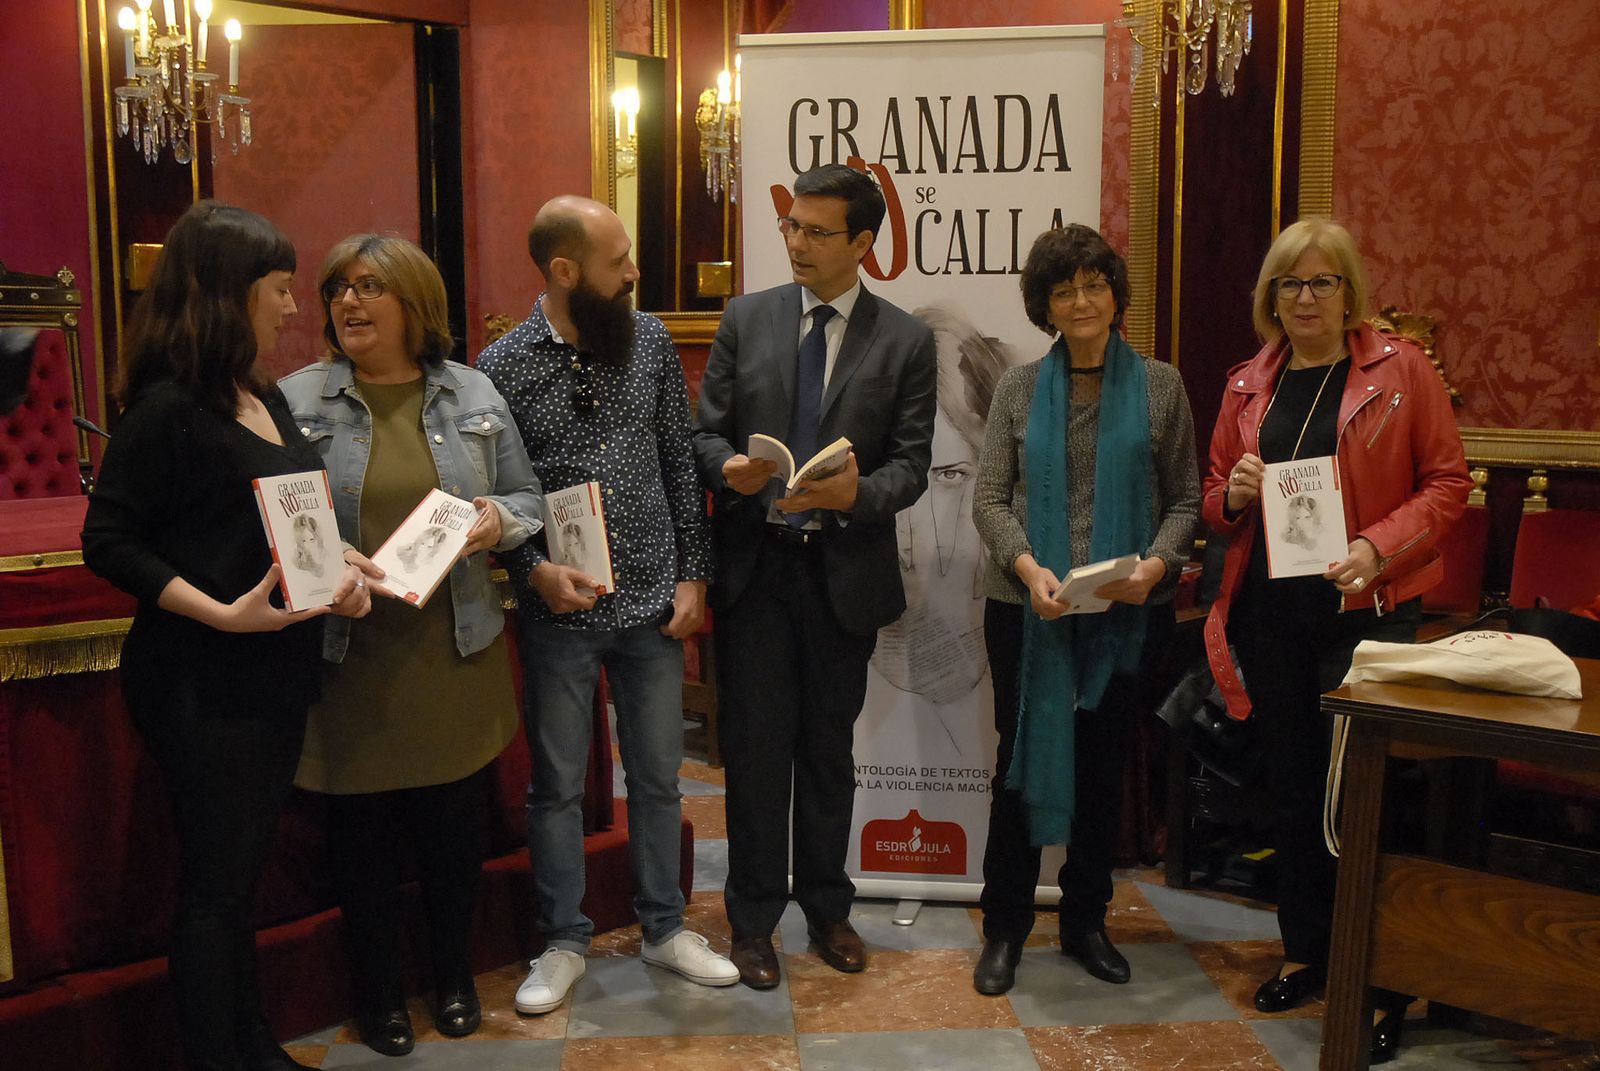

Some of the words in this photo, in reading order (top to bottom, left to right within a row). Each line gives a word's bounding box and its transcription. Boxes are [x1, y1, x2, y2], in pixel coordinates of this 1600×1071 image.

[787, 93, 1072, 176] GRANADA
[914, 185, 937, 204] se
[914, 208, 1066, 276] CALL
[1279, 465, 1321, 481] GRANADA
[277, 480, 316, 497] GRANADA
[1278, 475, 1299, 499] NO
[1298, 480, 1323, 493] CALLA
[278, 492, 300, 518] NO
[299, 497, 320, 511] CALLA
[439, 500, 472, 520] GRANADA
[553, 492, 582, 510] GRANADA
[428, 508, 450, 525] NO
[553, 505, 569, 527] NO
[854, 764, 917, 776] NTOLOGÍA
[920, 767, 938, 778] DE
[940, 768, 990, 779] TEXTOS
[867, 779, 883, 790] LA
[886, 780, 954, 792] VIOLENCIA
[957, 783, 993, 793] MACH
[889, 854, 939, 863] EDICIONES
